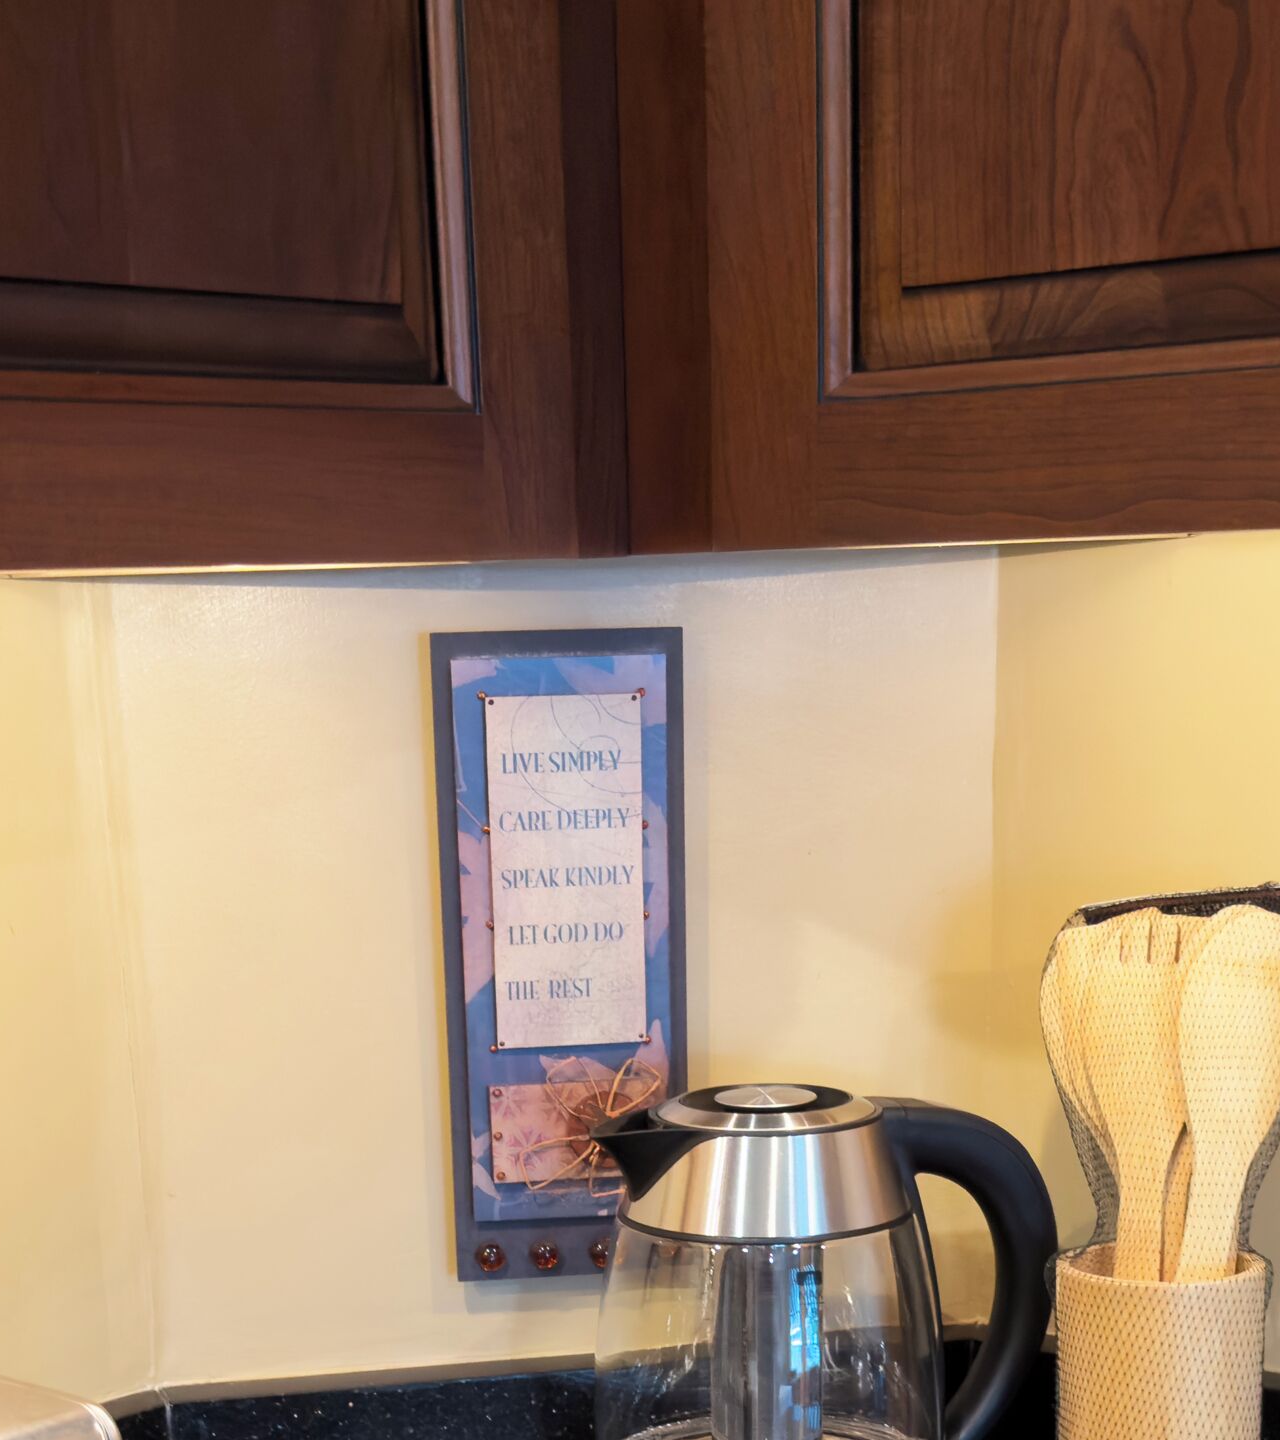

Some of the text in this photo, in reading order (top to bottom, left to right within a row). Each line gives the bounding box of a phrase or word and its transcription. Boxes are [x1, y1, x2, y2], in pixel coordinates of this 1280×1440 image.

[501, 750, 621, 774] LIVE SIMPLY
[499, 807, 630, 833] CARE DEEPLY
[501, 865, 634, 890] SPEAK KINDLY
[508, 921, 623, 946] LET GOD DO
[504, 977, 593, 1001] THE REST
